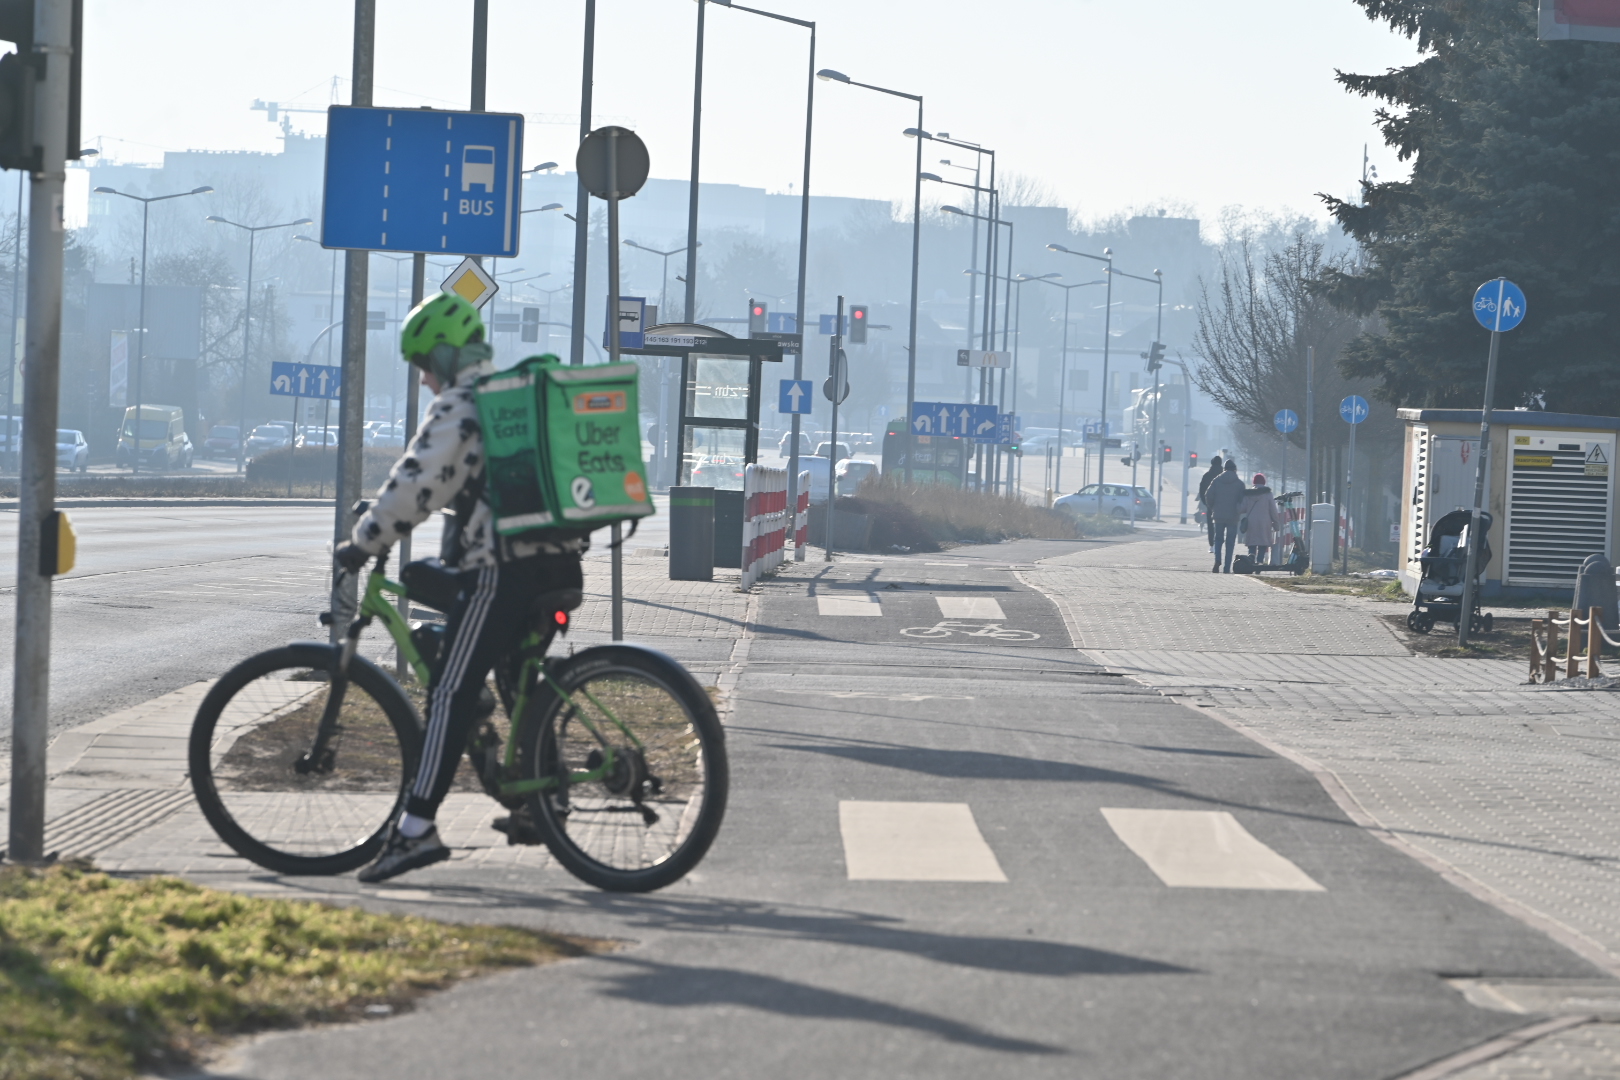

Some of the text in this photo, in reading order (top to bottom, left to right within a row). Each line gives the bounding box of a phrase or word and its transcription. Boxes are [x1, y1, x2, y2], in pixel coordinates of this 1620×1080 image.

[459, 199, 494, 216] BUS
[491, 407, 528, 421] Uber
[493, 422, 528, 439] Eats
[576, 421, 621, 446] Uber
[578, 451, 626, 473] Eats
